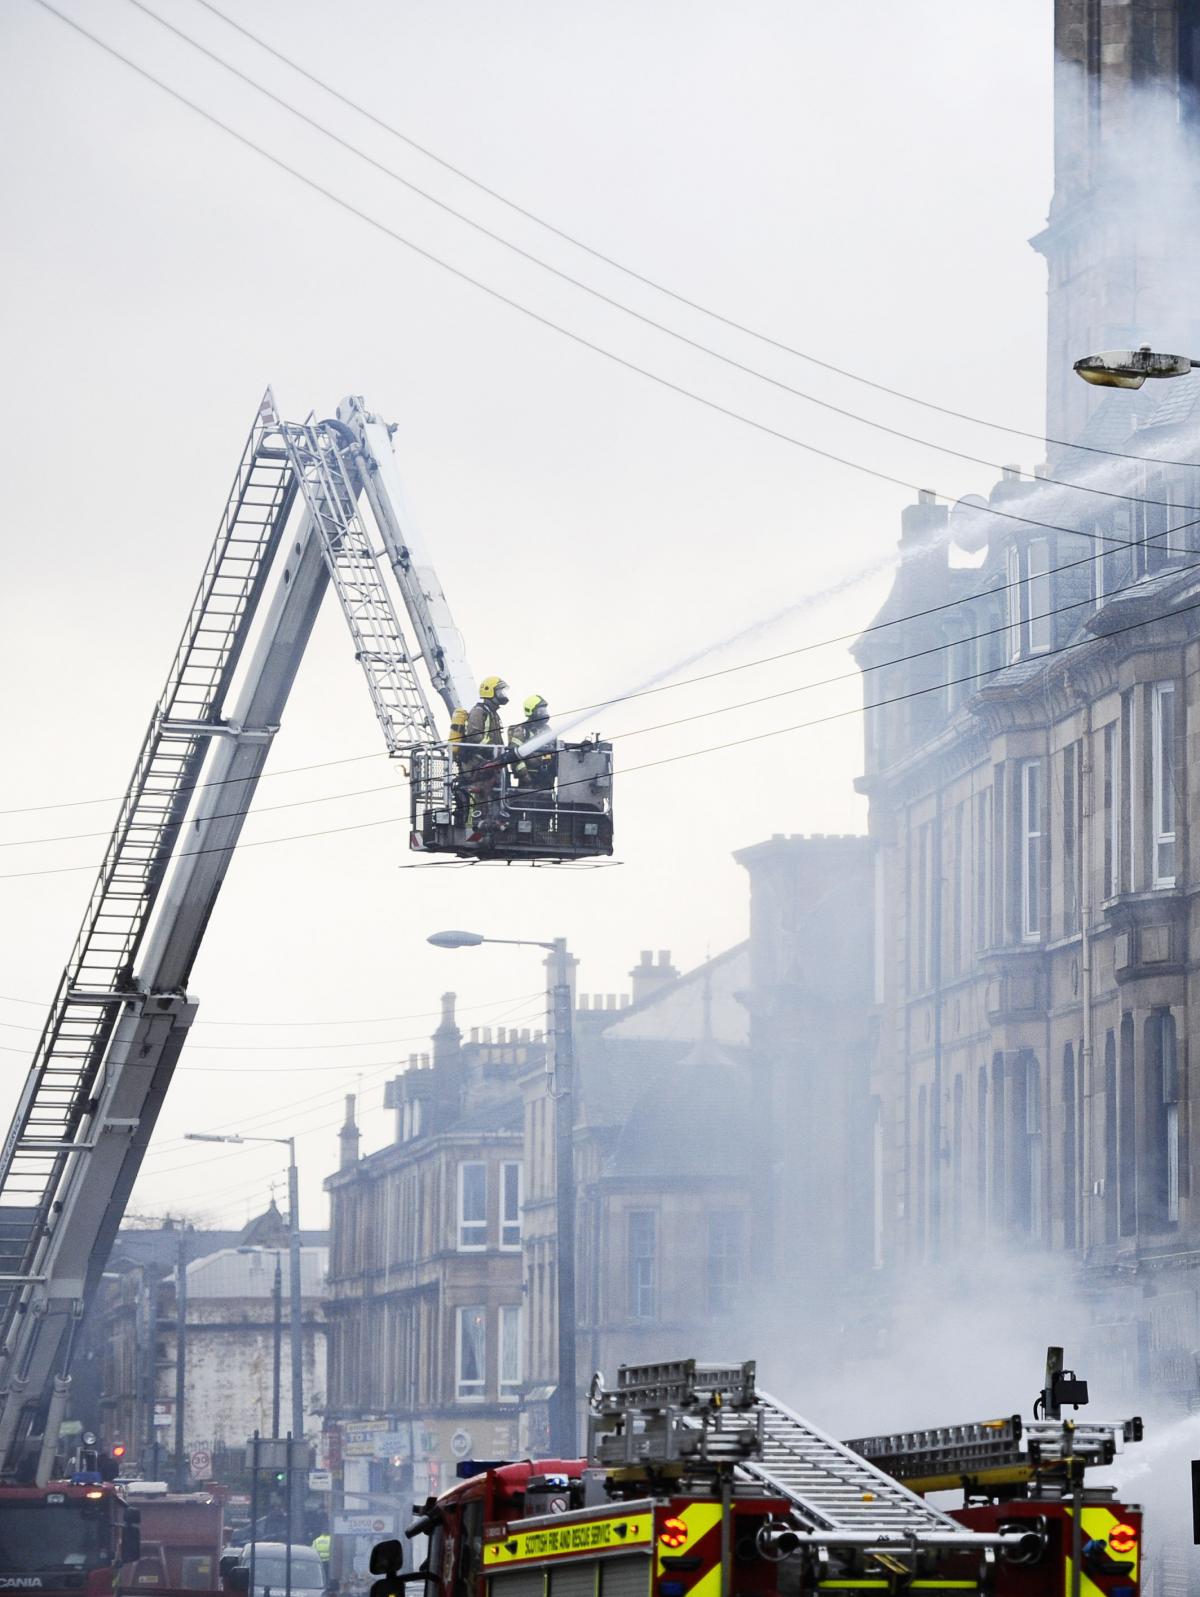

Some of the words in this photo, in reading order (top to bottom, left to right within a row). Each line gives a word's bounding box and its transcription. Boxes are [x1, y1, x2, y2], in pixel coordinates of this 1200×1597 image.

[194, 1456, 209, 1465] 30
[525, 1533, 547, 1554] SCOTTISH
[549, 1532, 558, 1551] FIRE
[560, 1530, 570, 1549] AND
[572, 1527, 590, 1547] RESCUE
[591, 1524, 611, 1545] SERVICE
[0, 1577, 43, 1588] CANIA
